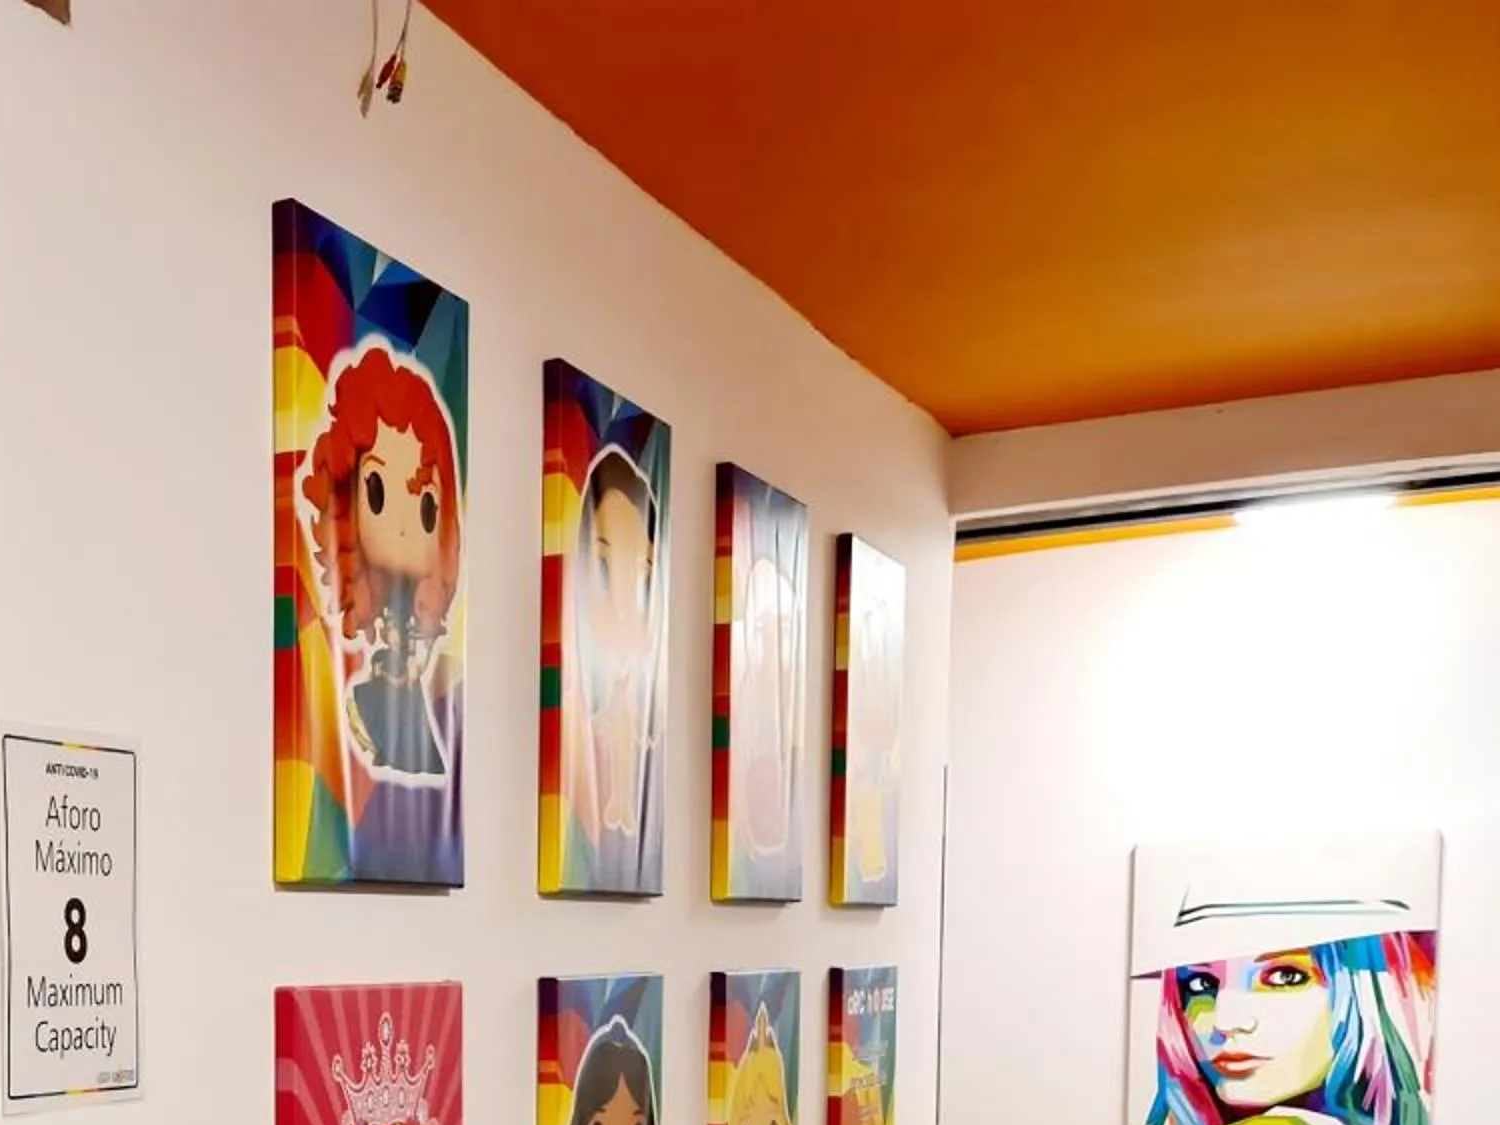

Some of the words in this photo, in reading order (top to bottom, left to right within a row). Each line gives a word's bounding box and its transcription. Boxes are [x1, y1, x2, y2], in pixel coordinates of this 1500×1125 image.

[45, 794, 101, 832] Aforo
[35, 838, 113, 877] Máximo
[63, 897, 88, 964] 8
[26, 973, 124, 1008] Maximum
[35, 1016, 118, 1060] Capacity
